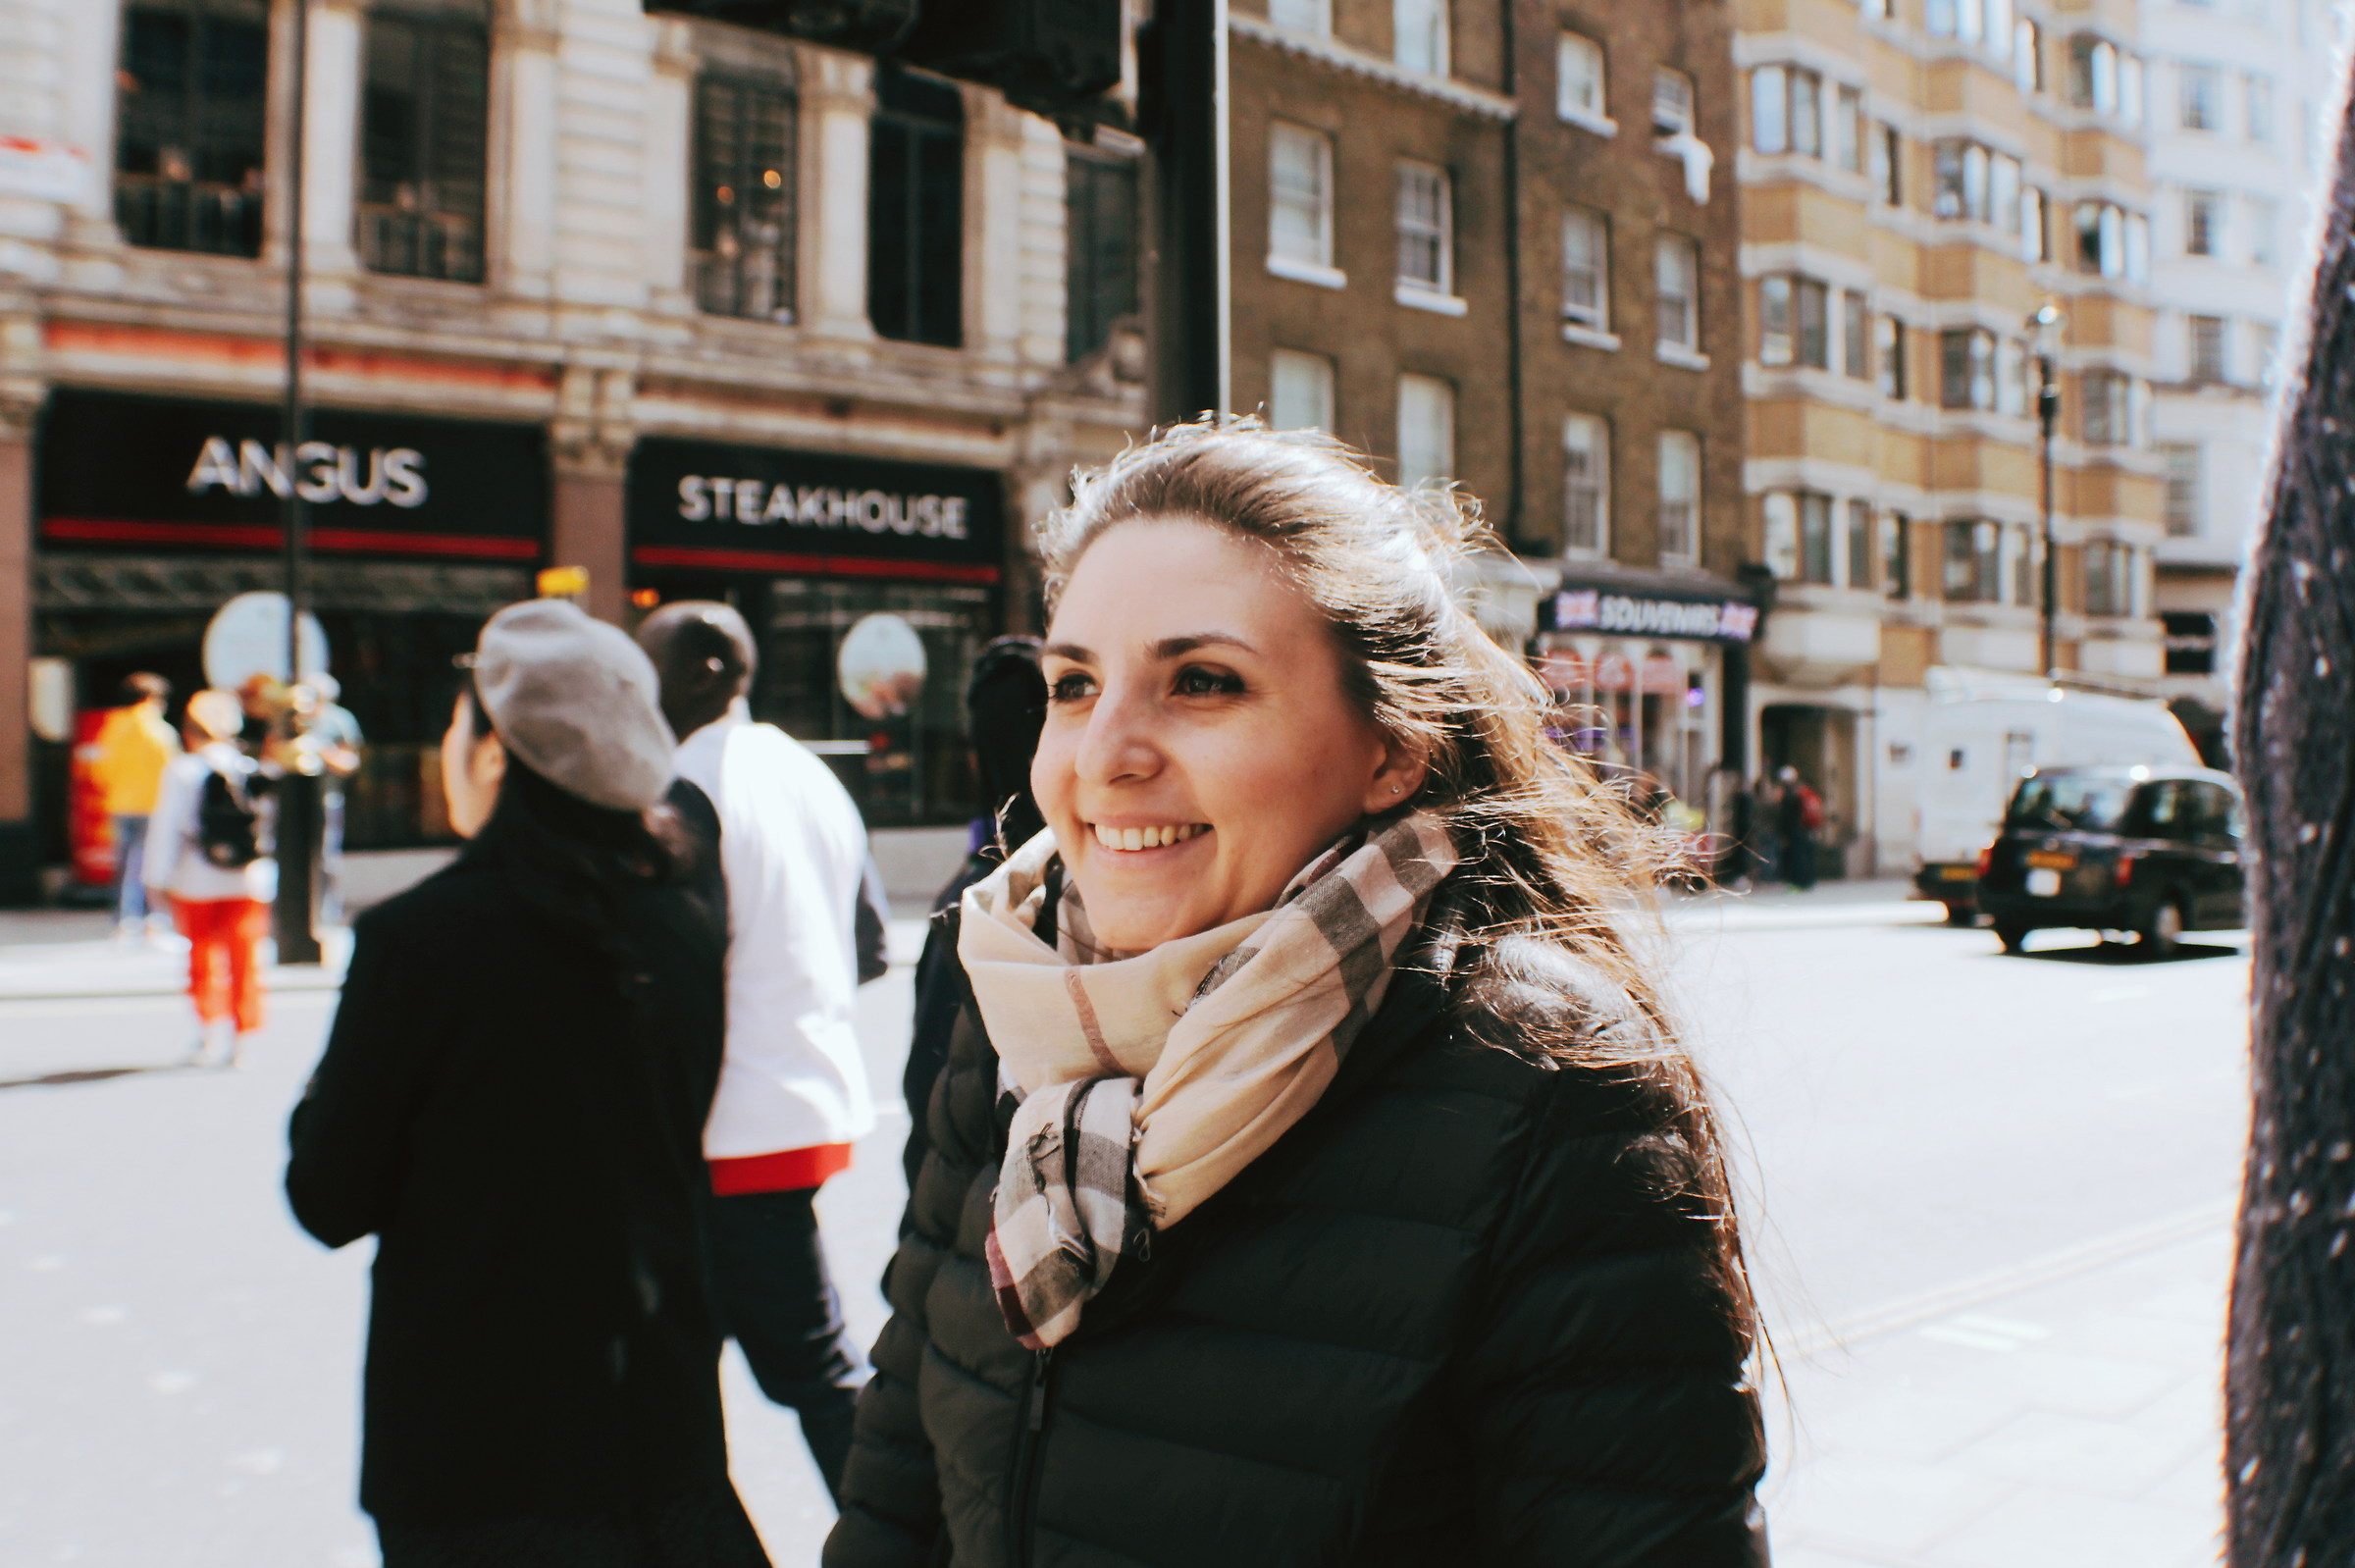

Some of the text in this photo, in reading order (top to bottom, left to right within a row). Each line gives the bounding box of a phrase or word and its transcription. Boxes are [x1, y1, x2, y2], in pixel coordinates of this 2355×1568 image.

[186, 436, 428, 508] ANGUS
[678, 475, 969, 540] STEAKHOUSE
[1599, 595, 1720, 636] SOUVENIRS
